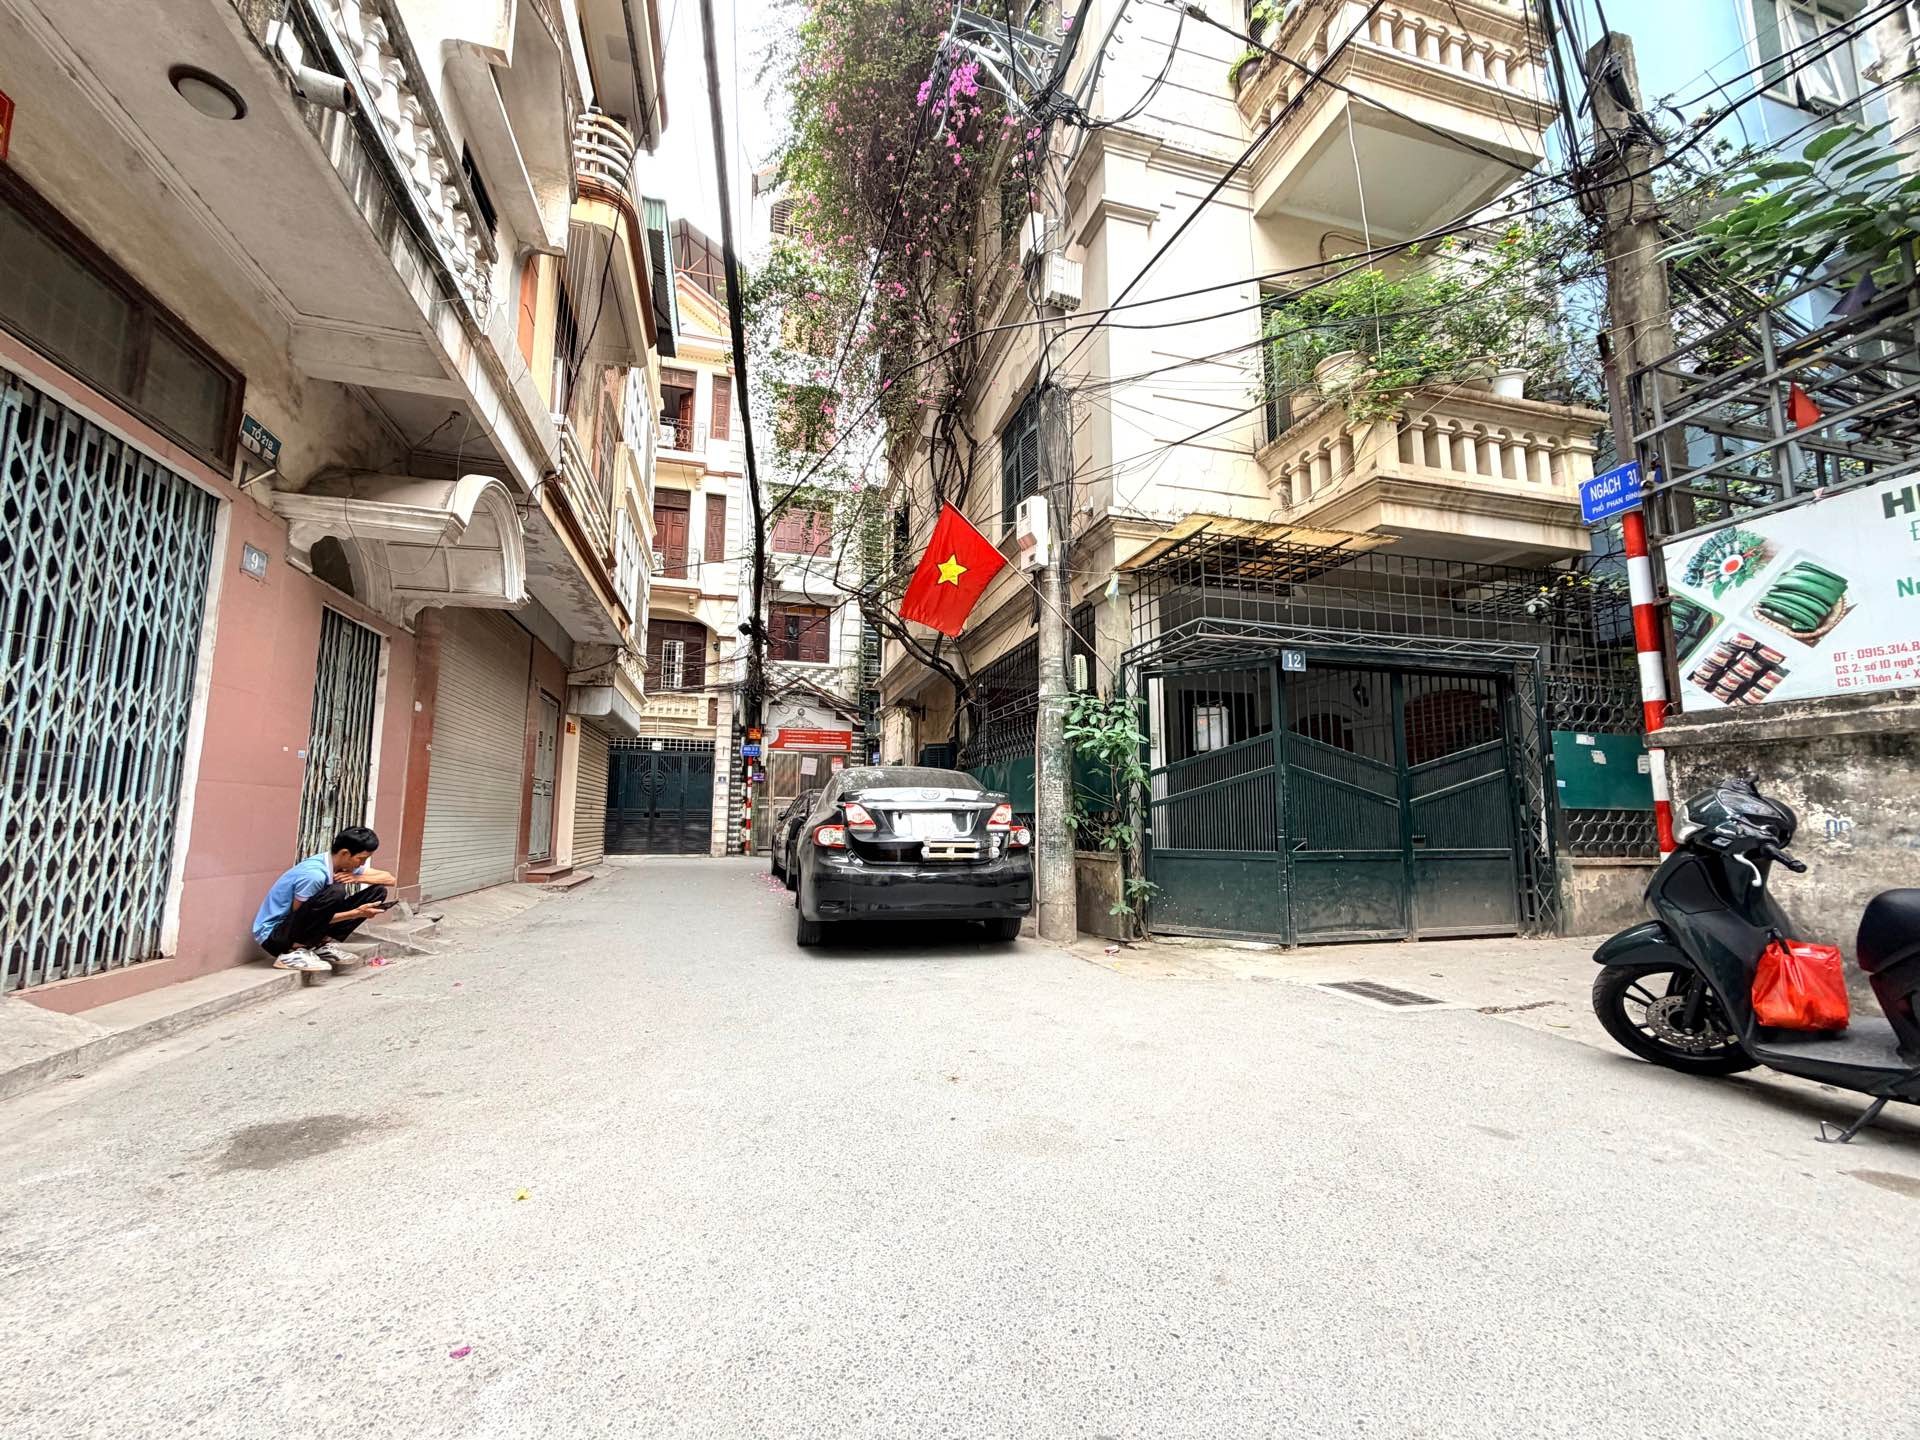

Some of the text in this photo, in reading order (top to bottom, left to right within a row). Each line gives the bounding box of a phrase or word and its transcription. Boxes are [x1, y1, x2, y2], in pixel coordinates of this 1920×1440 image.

[260, 435, 274, 450] 21B
[1589, 468, 1640, 501] NGÁCH 31
[1606, 497, 1624, 509] PHAN
[1881, 483, 1920, 519] H
[251, 552, 259, 569] 9
[1287, 653, 1302, 668] 12
[1835, 664, 1849, 675] CS
[1837, 677, 1852, 687] CS
[1894, 671, 1902, 680] 4
